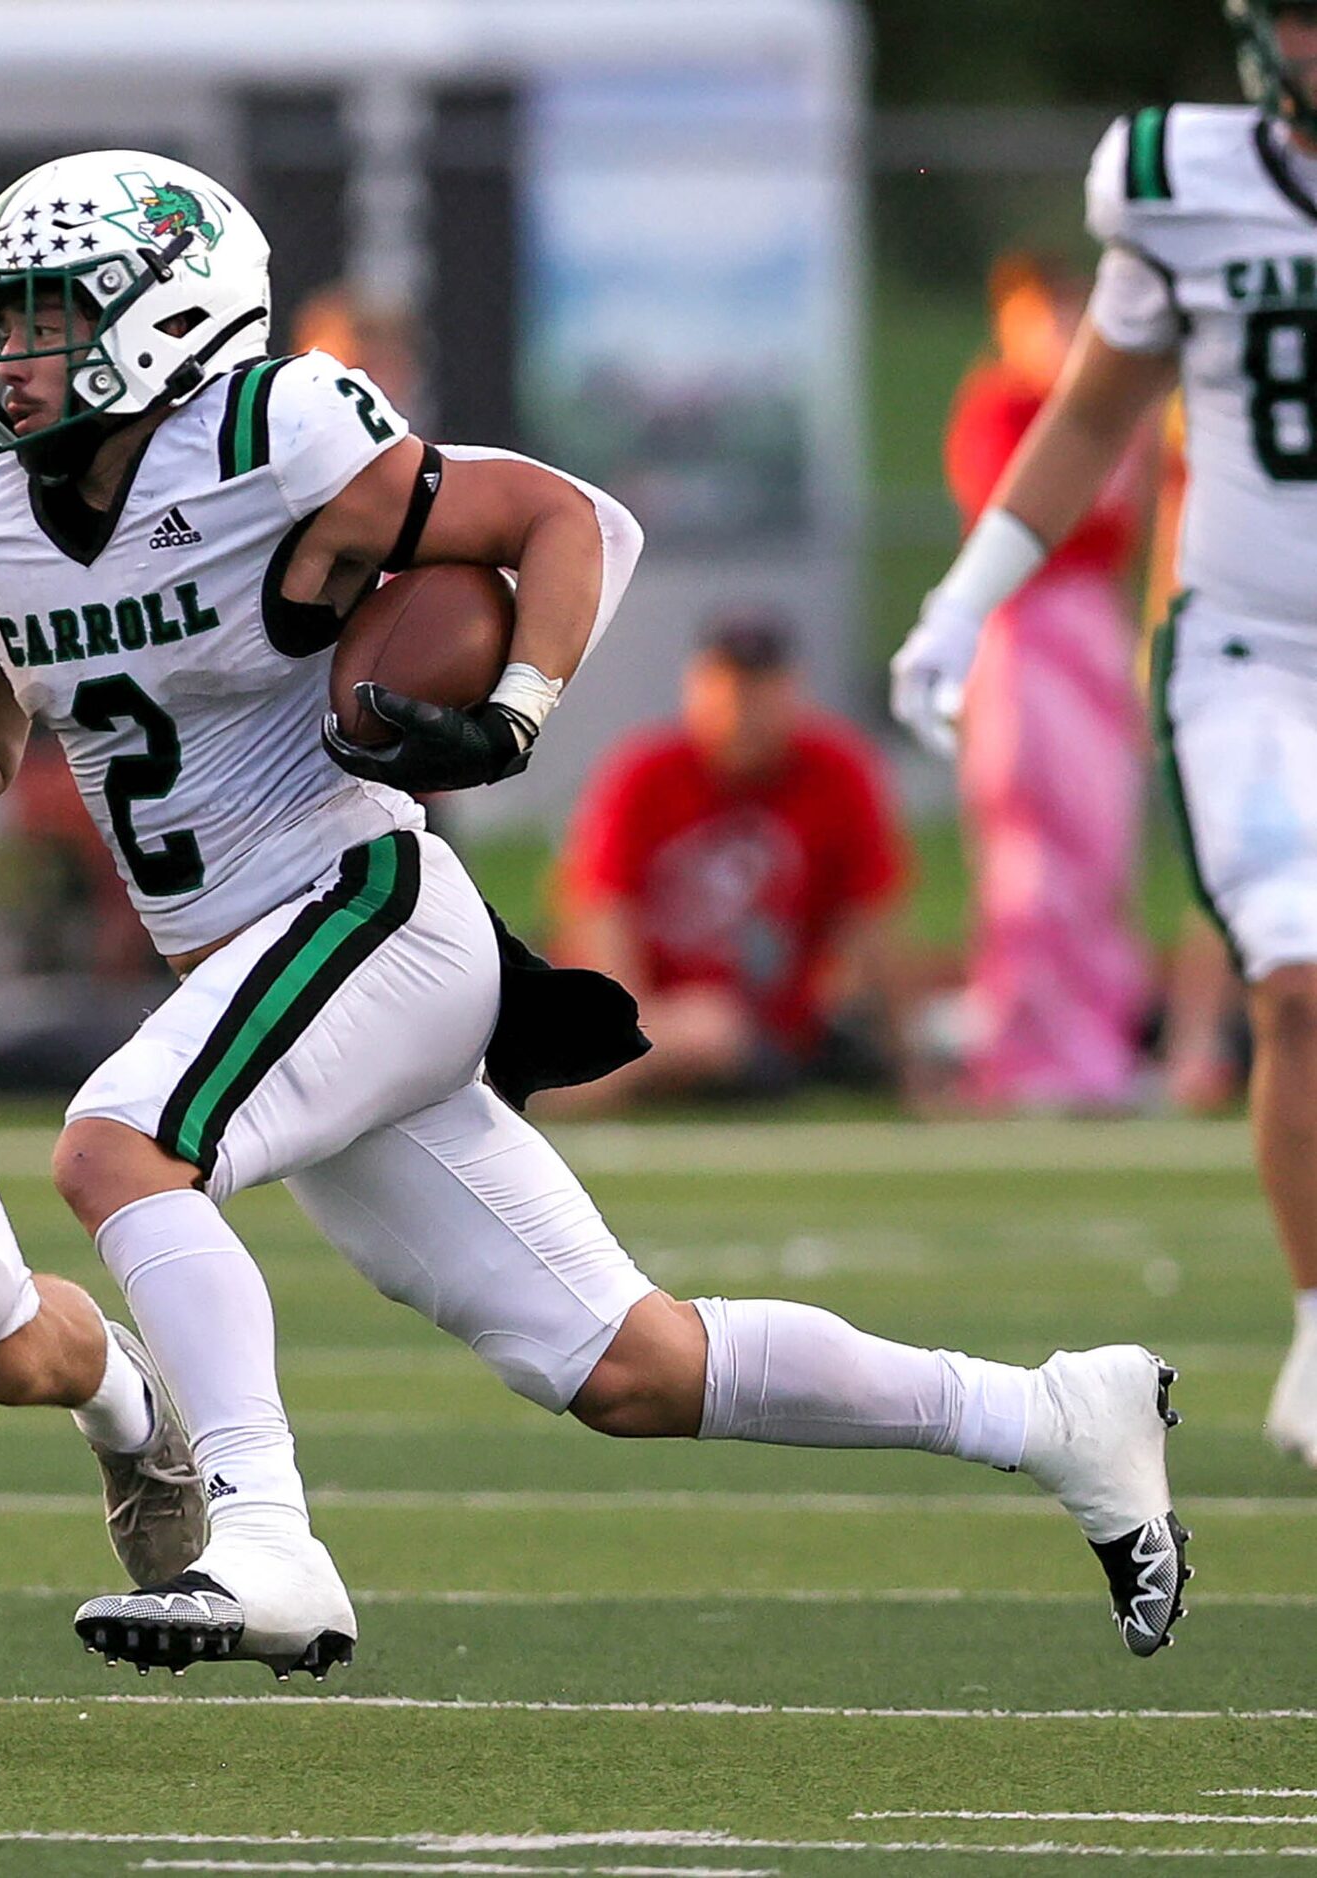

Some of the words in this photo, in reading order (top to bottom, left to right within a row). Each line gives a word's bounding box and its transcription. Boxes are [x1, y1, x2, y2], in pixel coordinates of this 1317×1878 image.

[335, 376, 395, 444] 2
[149, 531, 203, 550] adidas
[70, 672, 205, 899] 2
